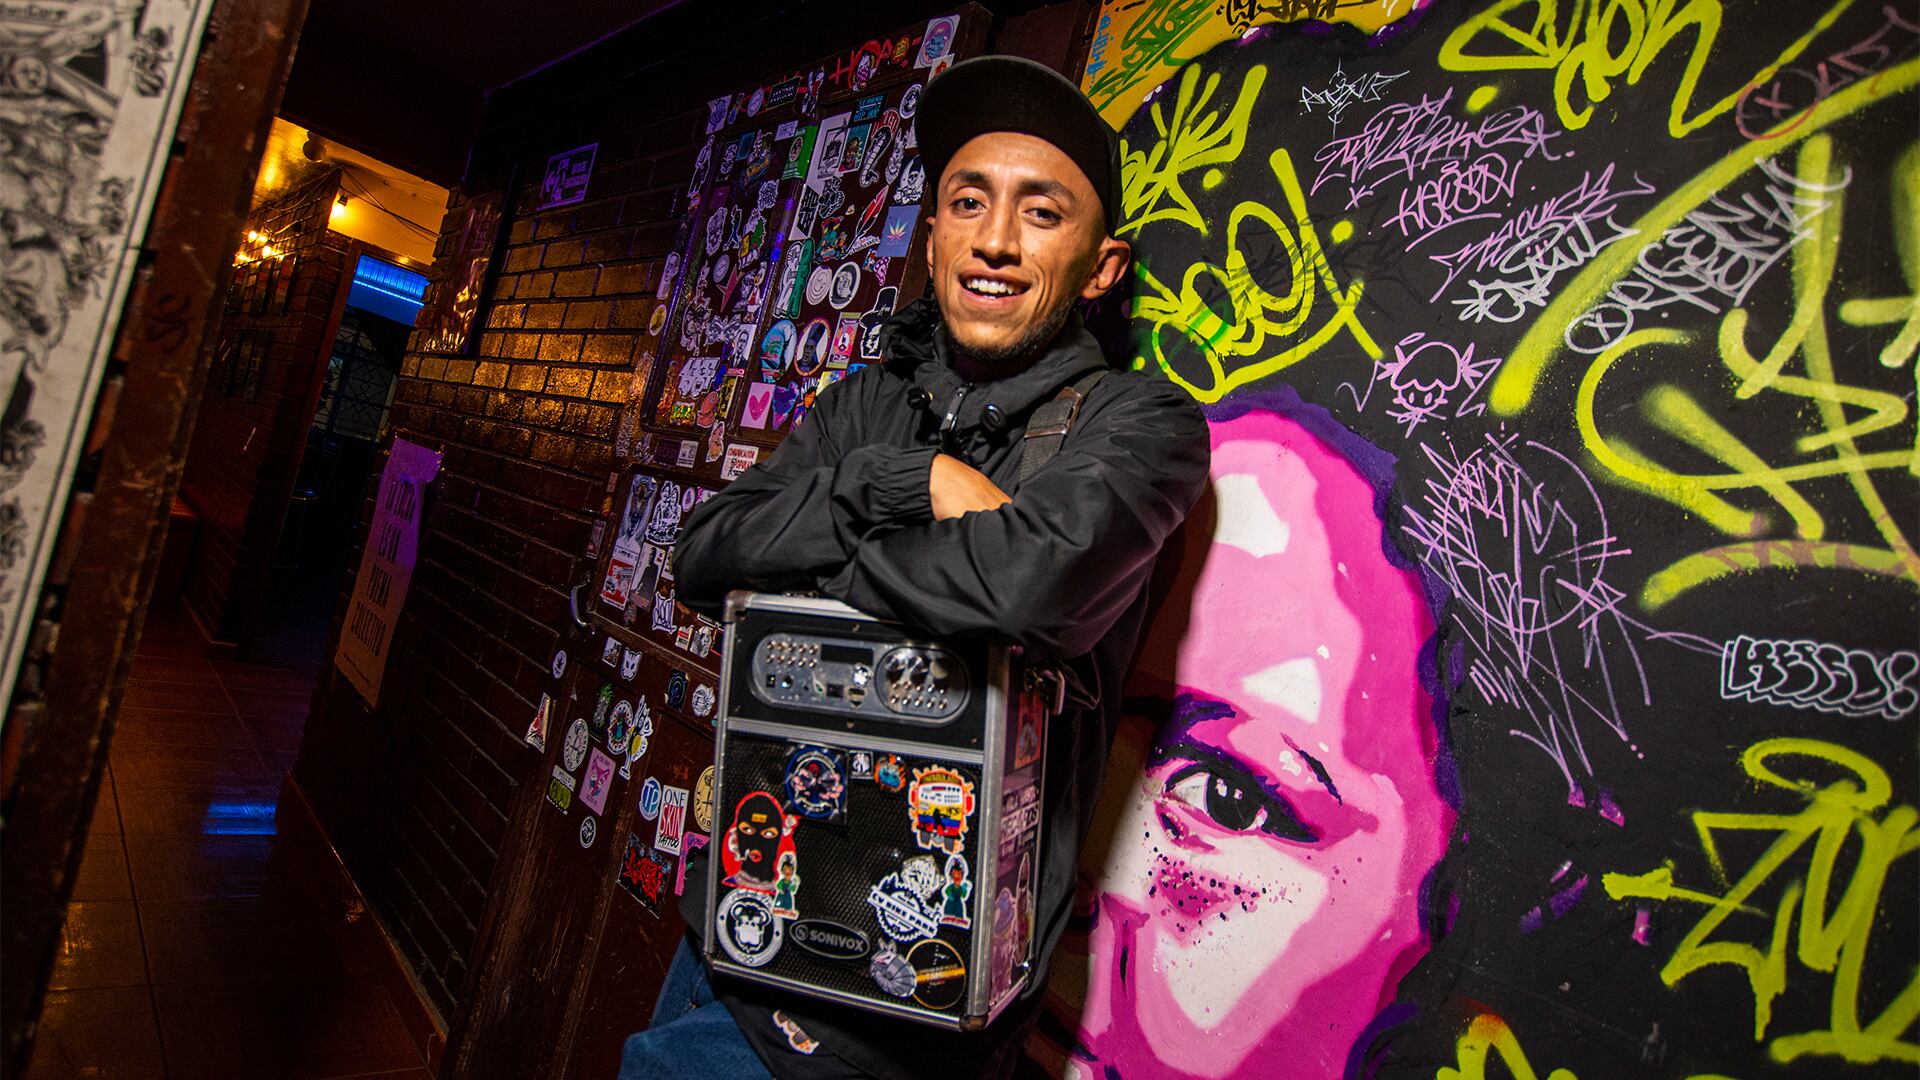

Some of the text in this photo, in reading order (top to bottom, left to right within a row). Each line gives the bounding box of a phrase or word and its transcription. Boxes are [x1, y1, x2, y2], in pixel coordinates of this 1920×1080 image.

[664, 788, 687, 808] ONE
[659, 804, 684, 840] SKIN
[657, 834, 680, 849] TATTOO
[872, 893, 884, 904] CV
[886, 902, 907, 916] BIKE
[909, 913, 936, 932] PARK
[810, 930, 864, 952] SONIVOX
